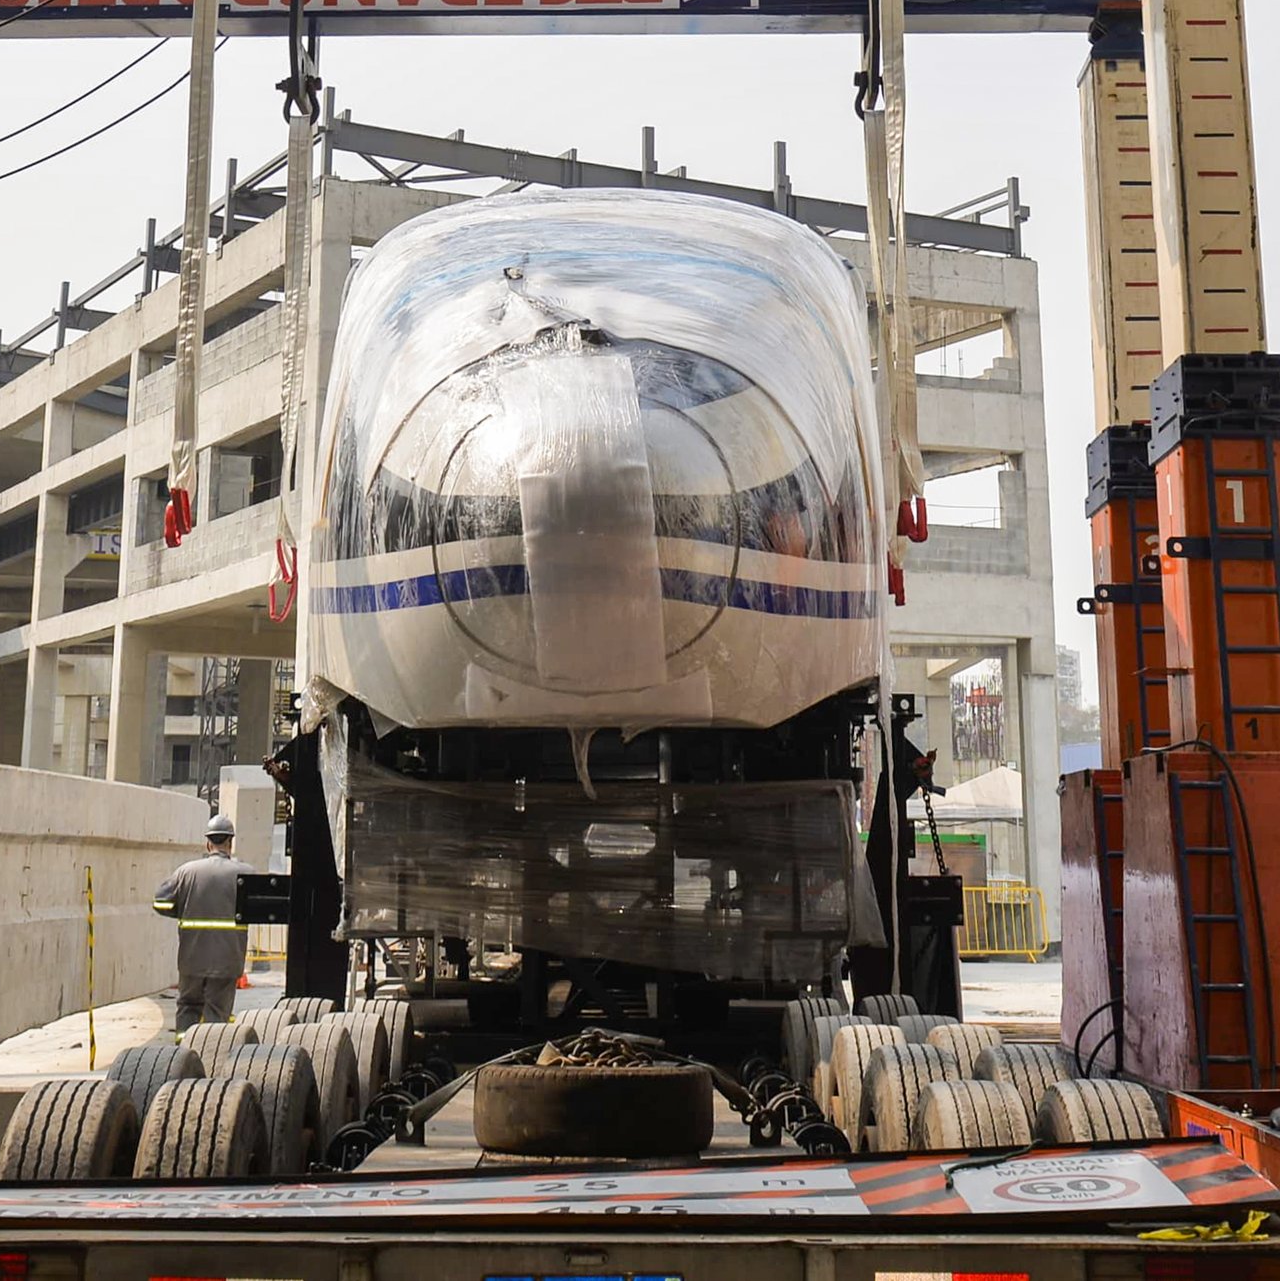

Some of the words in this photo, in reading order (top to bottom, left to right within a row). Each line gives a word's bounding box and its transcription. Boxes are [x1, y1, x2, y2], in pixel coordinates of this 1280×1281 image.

[1226, 480, 1245, 523] 1
[1245, 717, 1258, 740] 1
[29, 1188, 430, 1201] COMPRIMENTO
[535, 1180, 619, 1192] 25
[762, 1178, 805, 1187] m
[1020, 1178, 1111, 1195] 60
